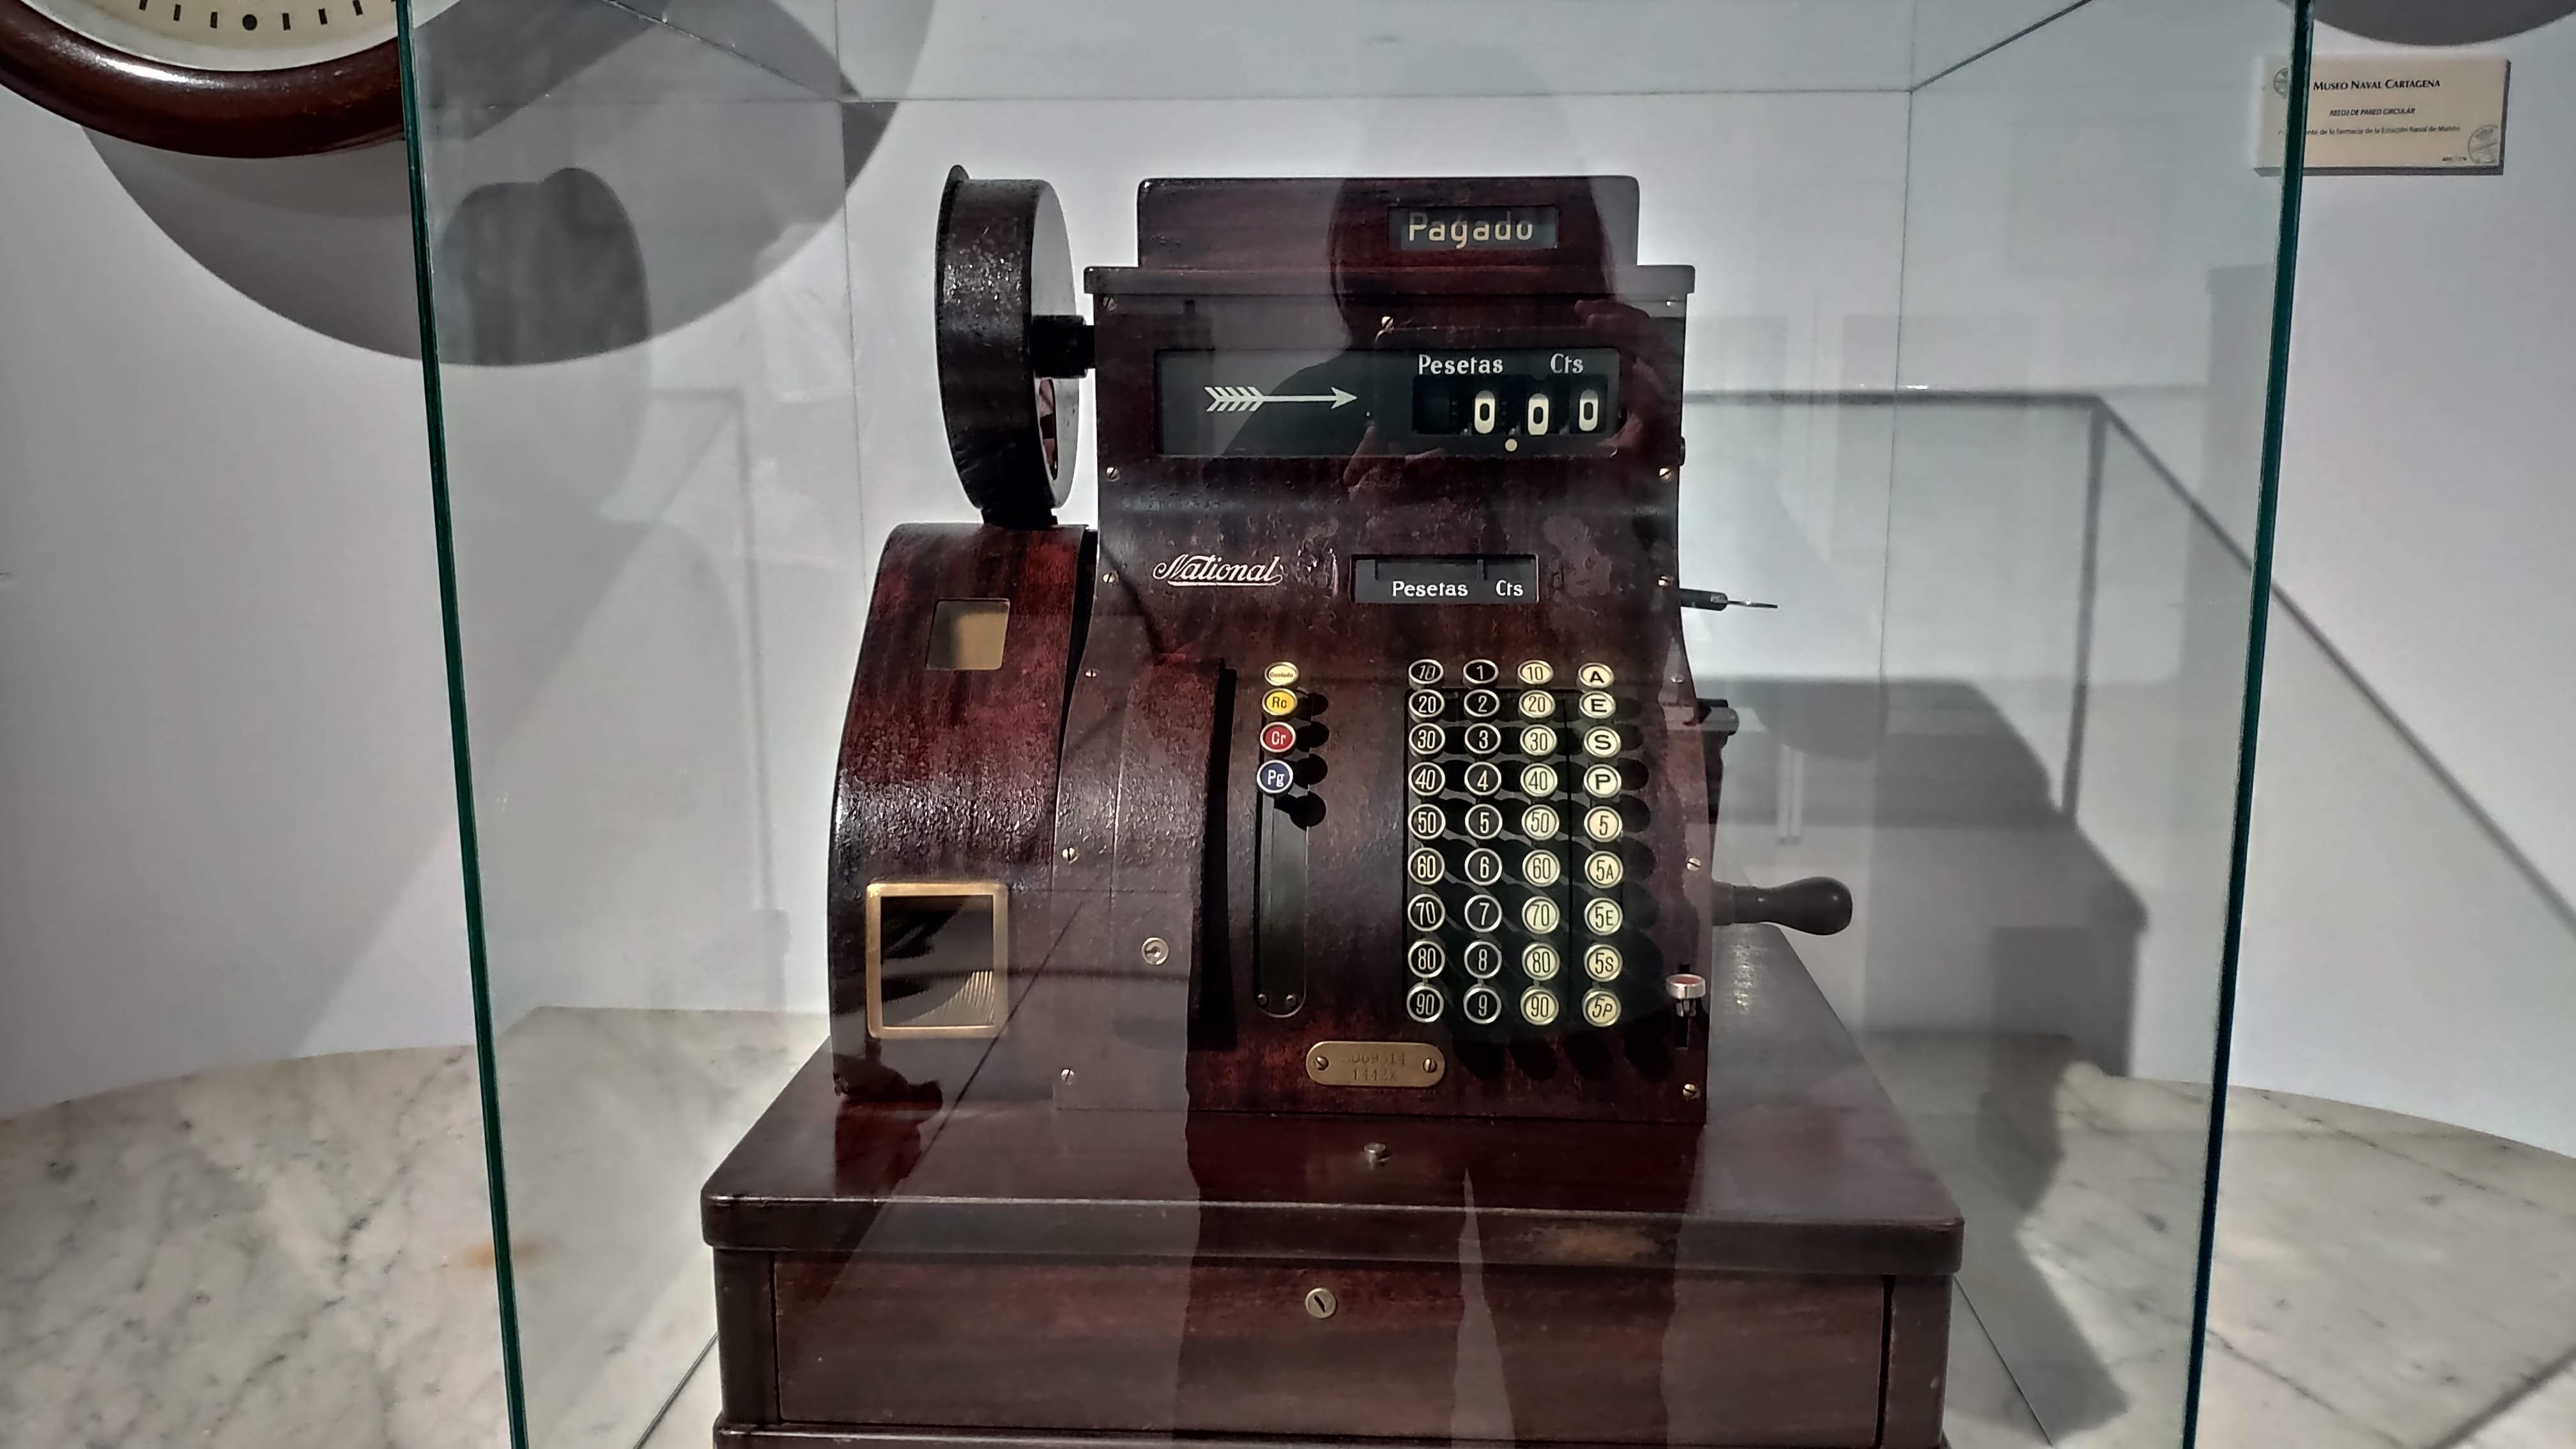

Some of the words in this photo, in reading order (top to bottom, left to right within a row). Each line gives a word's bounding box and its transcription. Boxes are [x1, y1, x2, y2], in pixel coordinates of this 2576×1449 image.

[2351, 80, 2382, 89] NAVAL
[2385, 79, 2441, 89] CARTAGENA
[1408, 210, 1533, 249] Pagado
[1418, 354, 1504, 375] Pesetas
[1550, 353, 1584, 374] Cts
[1474, 390, 1496, 434] 0
[1528, 393, 1549, 436] 0
[1579, 388, 1598, 432] 0
[1153, 554, 1284, 586] National
[1392, 581, 1469, 597] Pesetas
[1496, 581, 1524, 597] Cts
[1419, 664, 1436, 680] 10
[1476, 665, 1483, 680] 1
[1527, 666, 1544, 680] 10
[1590, 671, 1605, 684] A
[1272, 696, 1287, 709] Rc
[1418, 696, 1436, 713] 20
[1478, 696, 1487, 713] 2
[1528, 696, 1545, 712] 20
[1591, 699, 1607, 713] E
[1271, 731, 1287, 746] Cr
[1417, 730, 1436, 749] 30
[1479, 730, 1489, 749] 3
[1530, 733, 1548, 751] 30
[1594, 735, 1612, 750] S
[1268, 769, 1285, 788] Pg
[1414, 769, 1436, 790] 40
[1477, 770, 1489, 790] 4
[1529, 770, 1548, 791] 40
[1595, 774, 1611, 790] P
[1418, 811, 1436, 833] 50
[1480, 812, 1490, 834] 5
[1530, 812, 1549, 834] 50
[1599, 815, 1609, 836] 5
[1417, 855, 1436, 879] 60
[1480, 855, 1489, 879] 6
[1532, 857, 1551, 880] 60
[1596, 859, 1614, 881] 5A
[1416, 901, 1436, 926] 70
[1479, 902, 1490, 926] 7
[1532, 903, 1551, 927] 70
[1595, 906, 1614, 928] 5E
[1418, 947, 1436, 970] 80
[1478, 948, 1488, 972] 8
[1533, 951, 1551, 973] 80
[1595, 953, 1614, 974] 5S
[1416, 993, 1435, 1015] 90
[1478, 994, 1488, 1017] 9
[1531, 996, 1549, 1018] 90
[1592, 998, 1613, 1018] 5P
